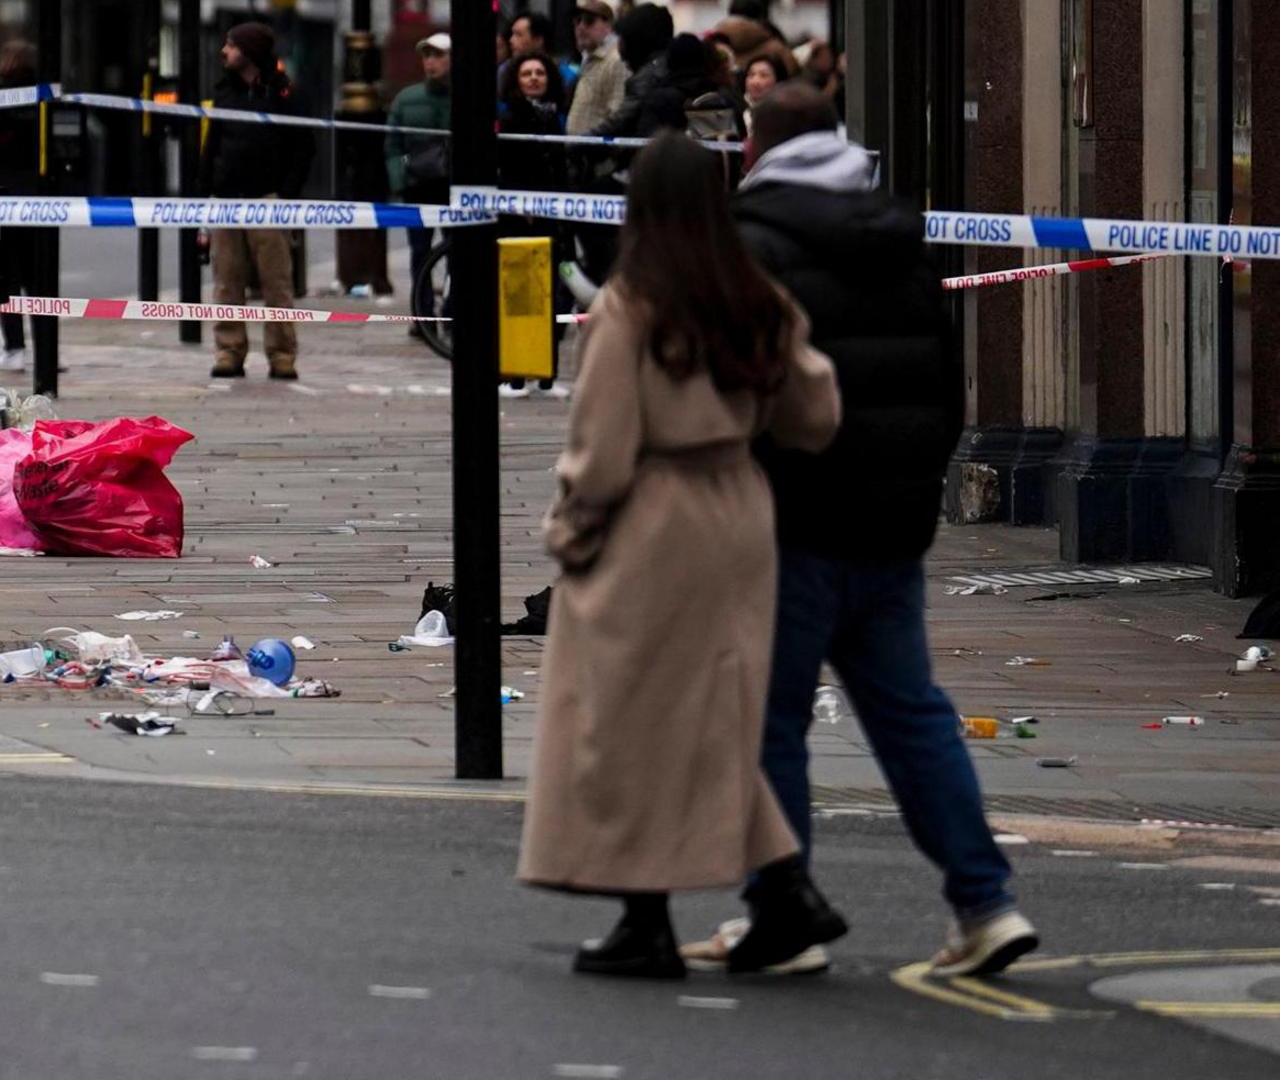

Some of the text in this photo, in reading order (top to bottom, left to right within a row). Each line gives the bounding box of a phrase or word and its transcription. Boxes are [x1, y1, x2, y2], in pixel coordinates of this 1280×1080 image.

[20, 200, 71, 221] CROSS
[151, 203, 357, 225] POLICE LINE DO NOT CROSS
[460, 193, 626, 220] POLICE LINE DO NOT
[954, 216, 1012, 241] CROSS
[1108, 224, 1280, 256] POLICE LINE DO NOT
